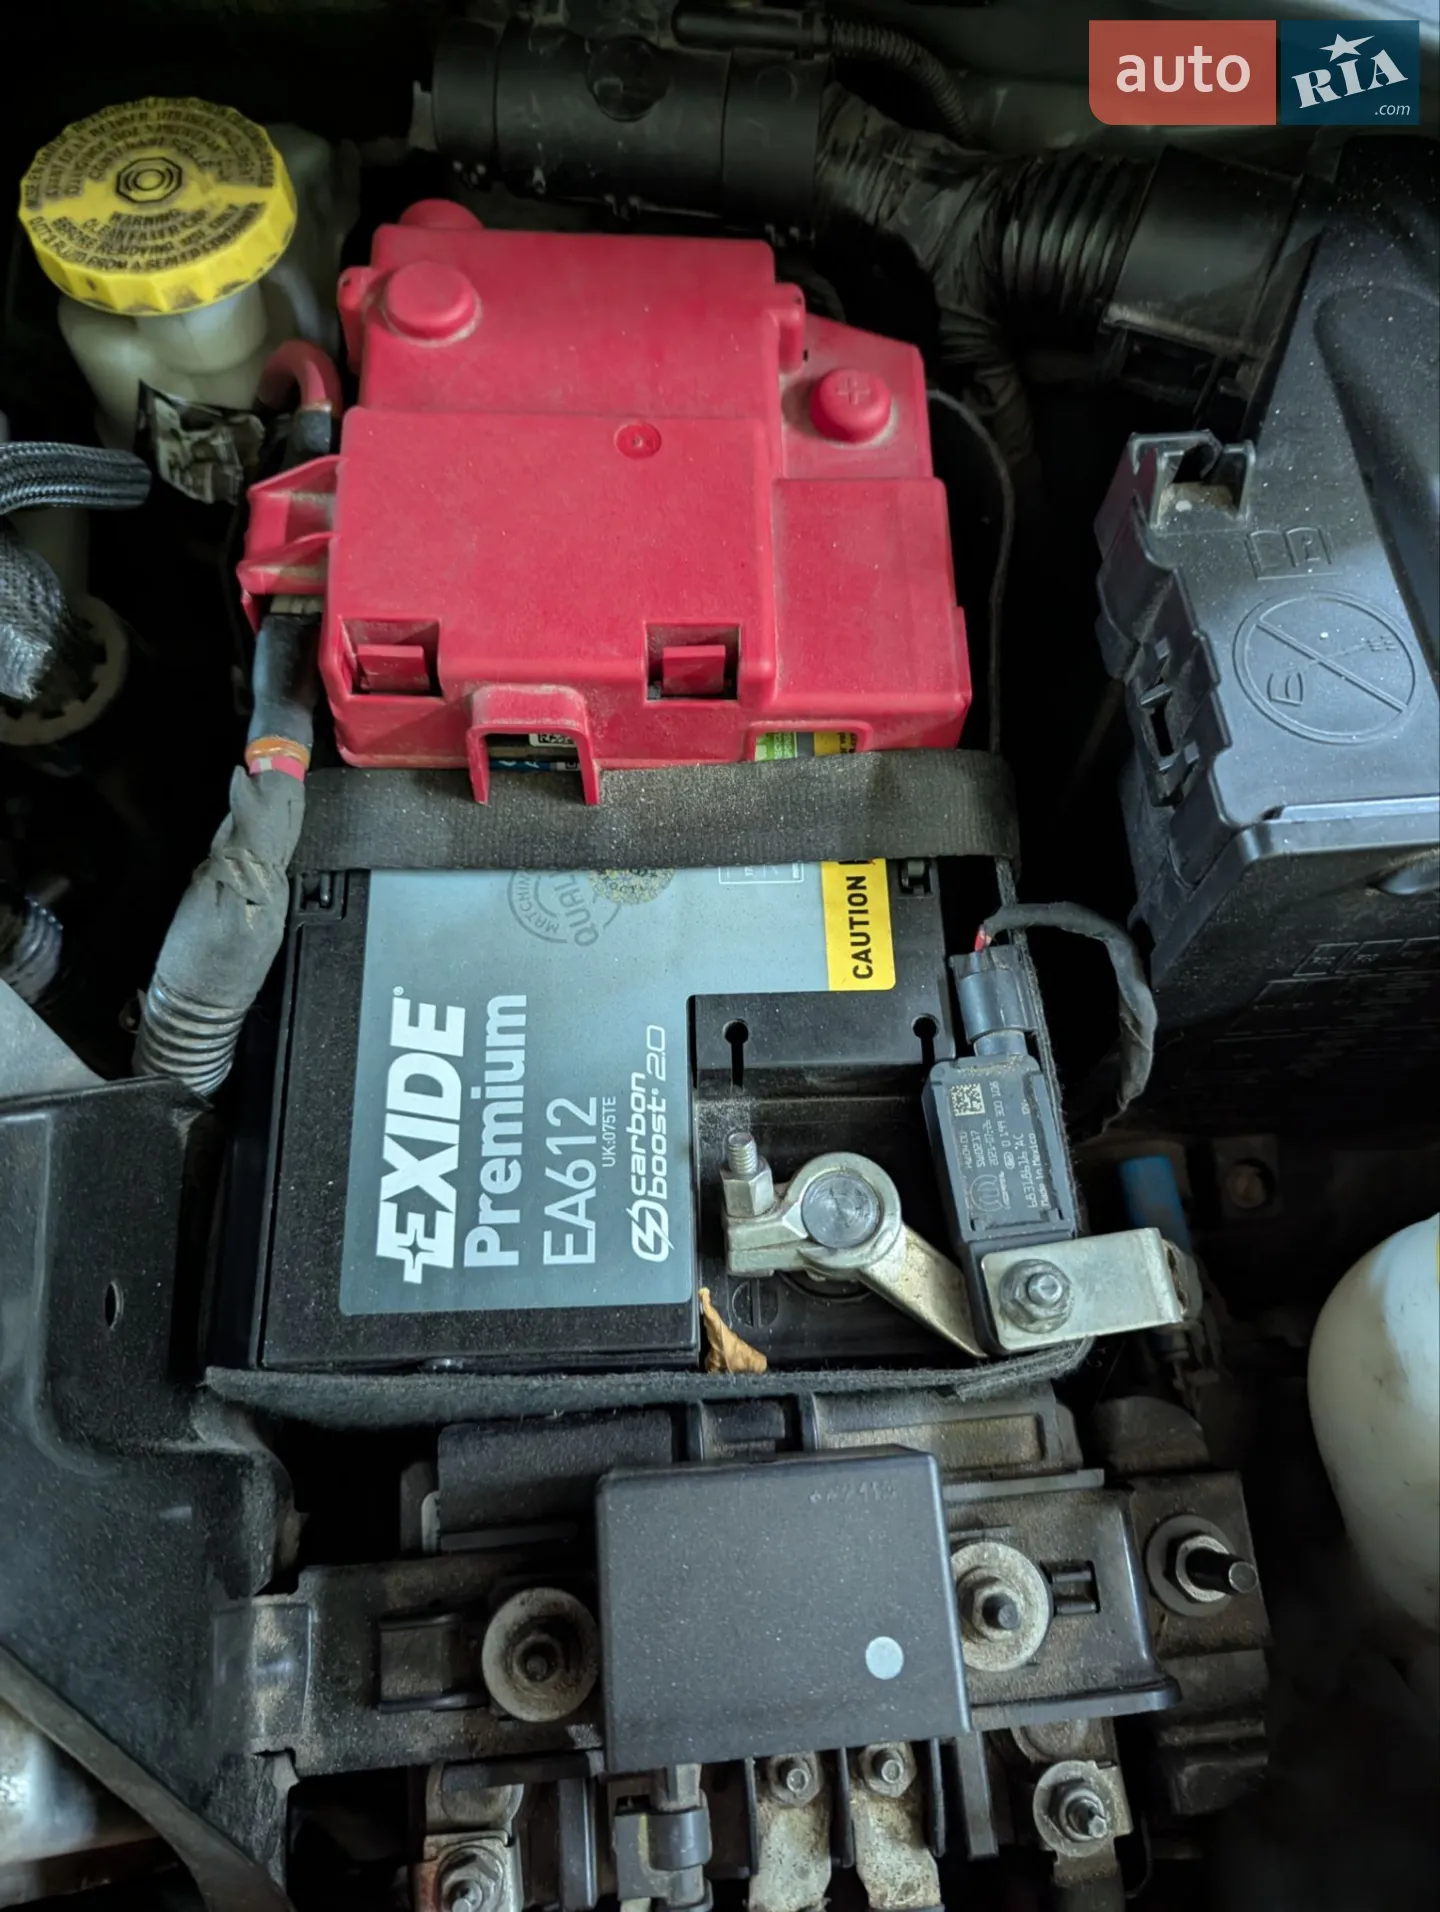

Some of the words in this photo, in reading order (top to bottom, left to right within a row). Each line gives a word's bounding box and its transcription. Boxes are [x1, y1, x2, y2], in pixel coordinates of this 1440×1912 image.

[846, 875, 873, 980] CAUTION
[646, 1024, 666, 1082] 2.0
[377, 996, 466, 1284] EXIDE
[464, 995, 527, 1267] Premium
[543, 1096, 598, 1266] EA612
[602, 1096, 616, 1168] UK:075TE
[626, 1071, 647, 1197] carbon
[1028, 1133, 1041, 1166] Mexico
